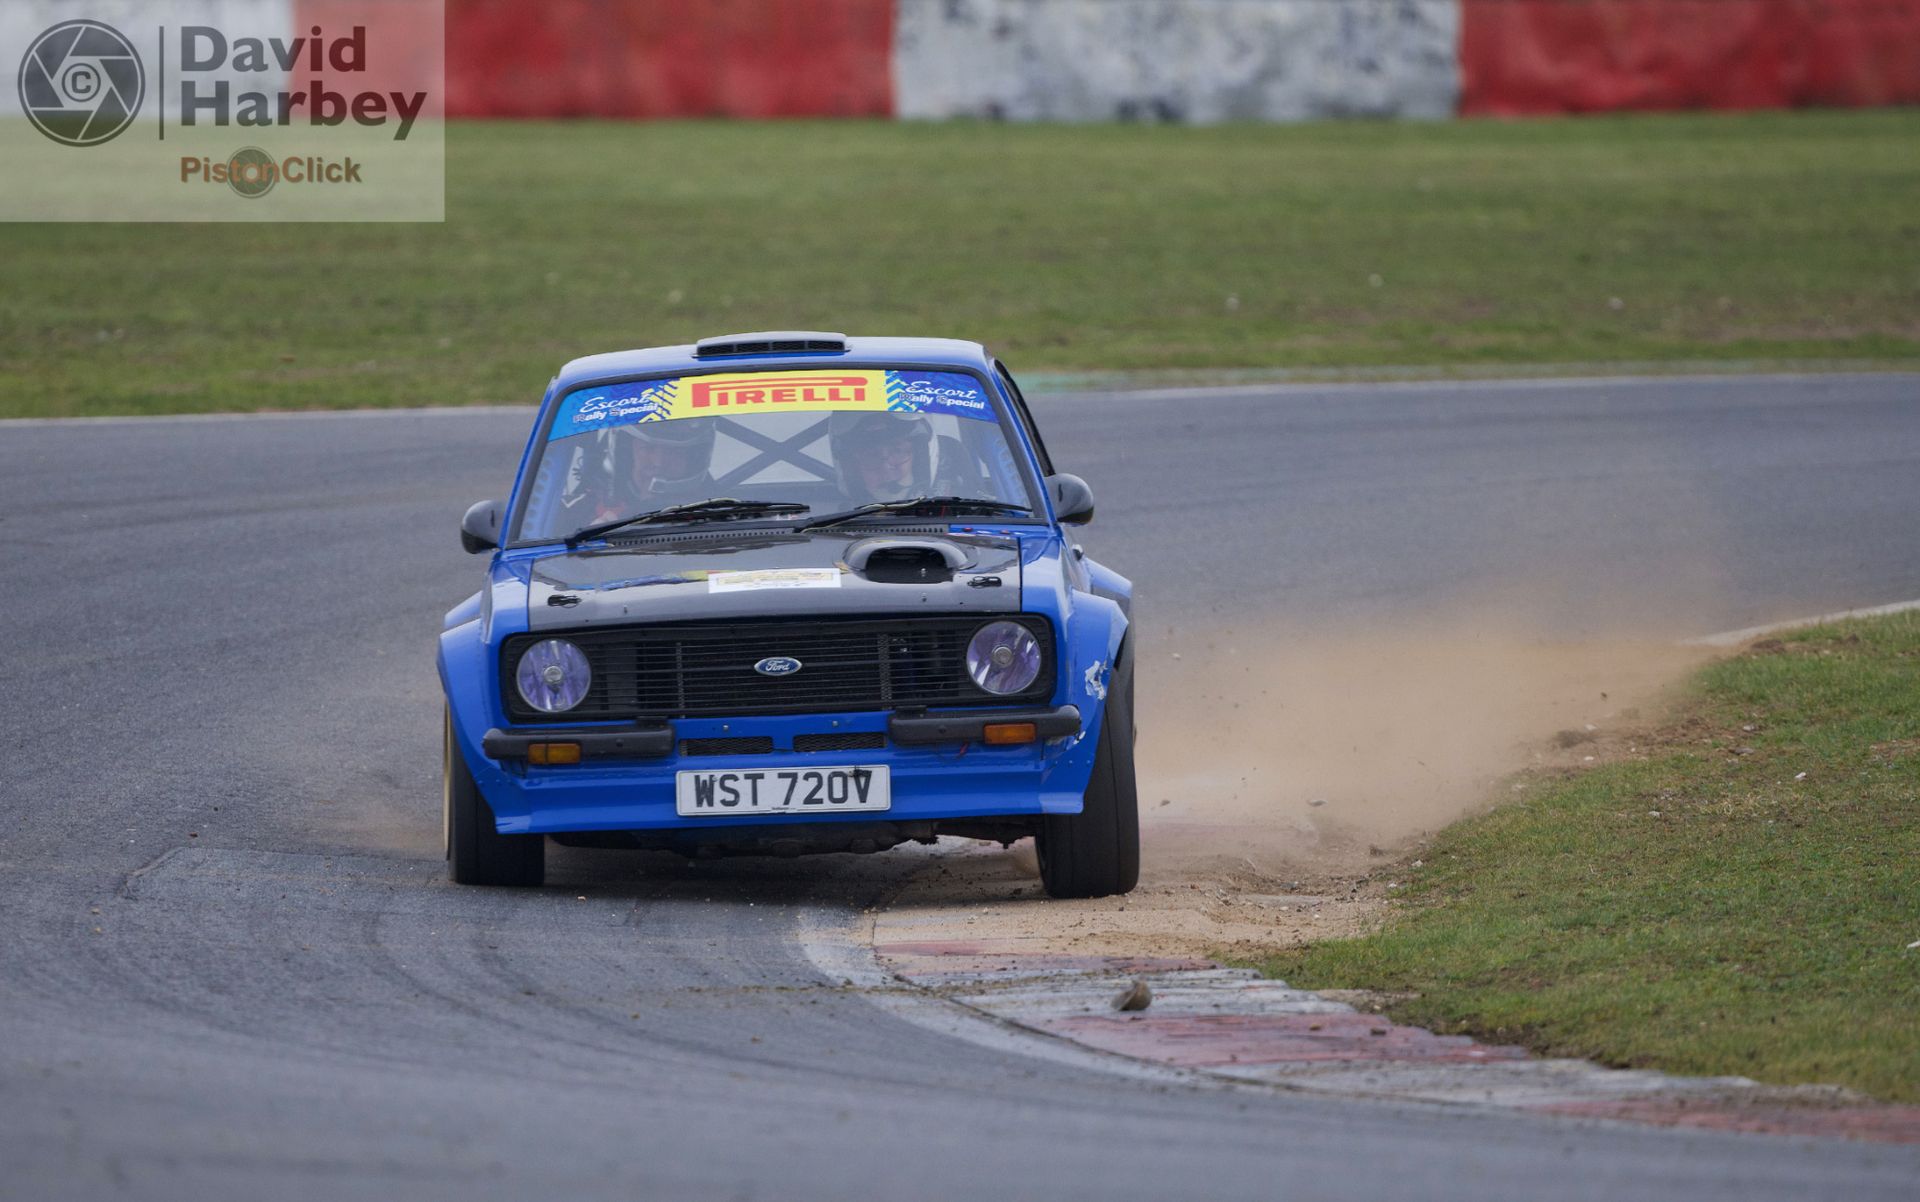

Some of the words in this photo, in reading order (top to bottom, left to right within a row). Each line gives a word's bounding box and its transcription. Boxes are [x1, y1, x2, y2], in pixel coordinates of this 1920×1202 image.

[692, 377, 868, 408] PIRELLI
[905, 381, 978, 399] Escort
[579, 394, 651, 413] Escort
[900, 393, 934, 405] Rally
[936, 395, 985, 409] Special
[573, 411, 607, 423] Rally
[609, 402, 659, 416] Special
[765, 660, 791, 671] Ford
[694, 773, 765, 808] WST
[777, 770, 872, 806] 720V
